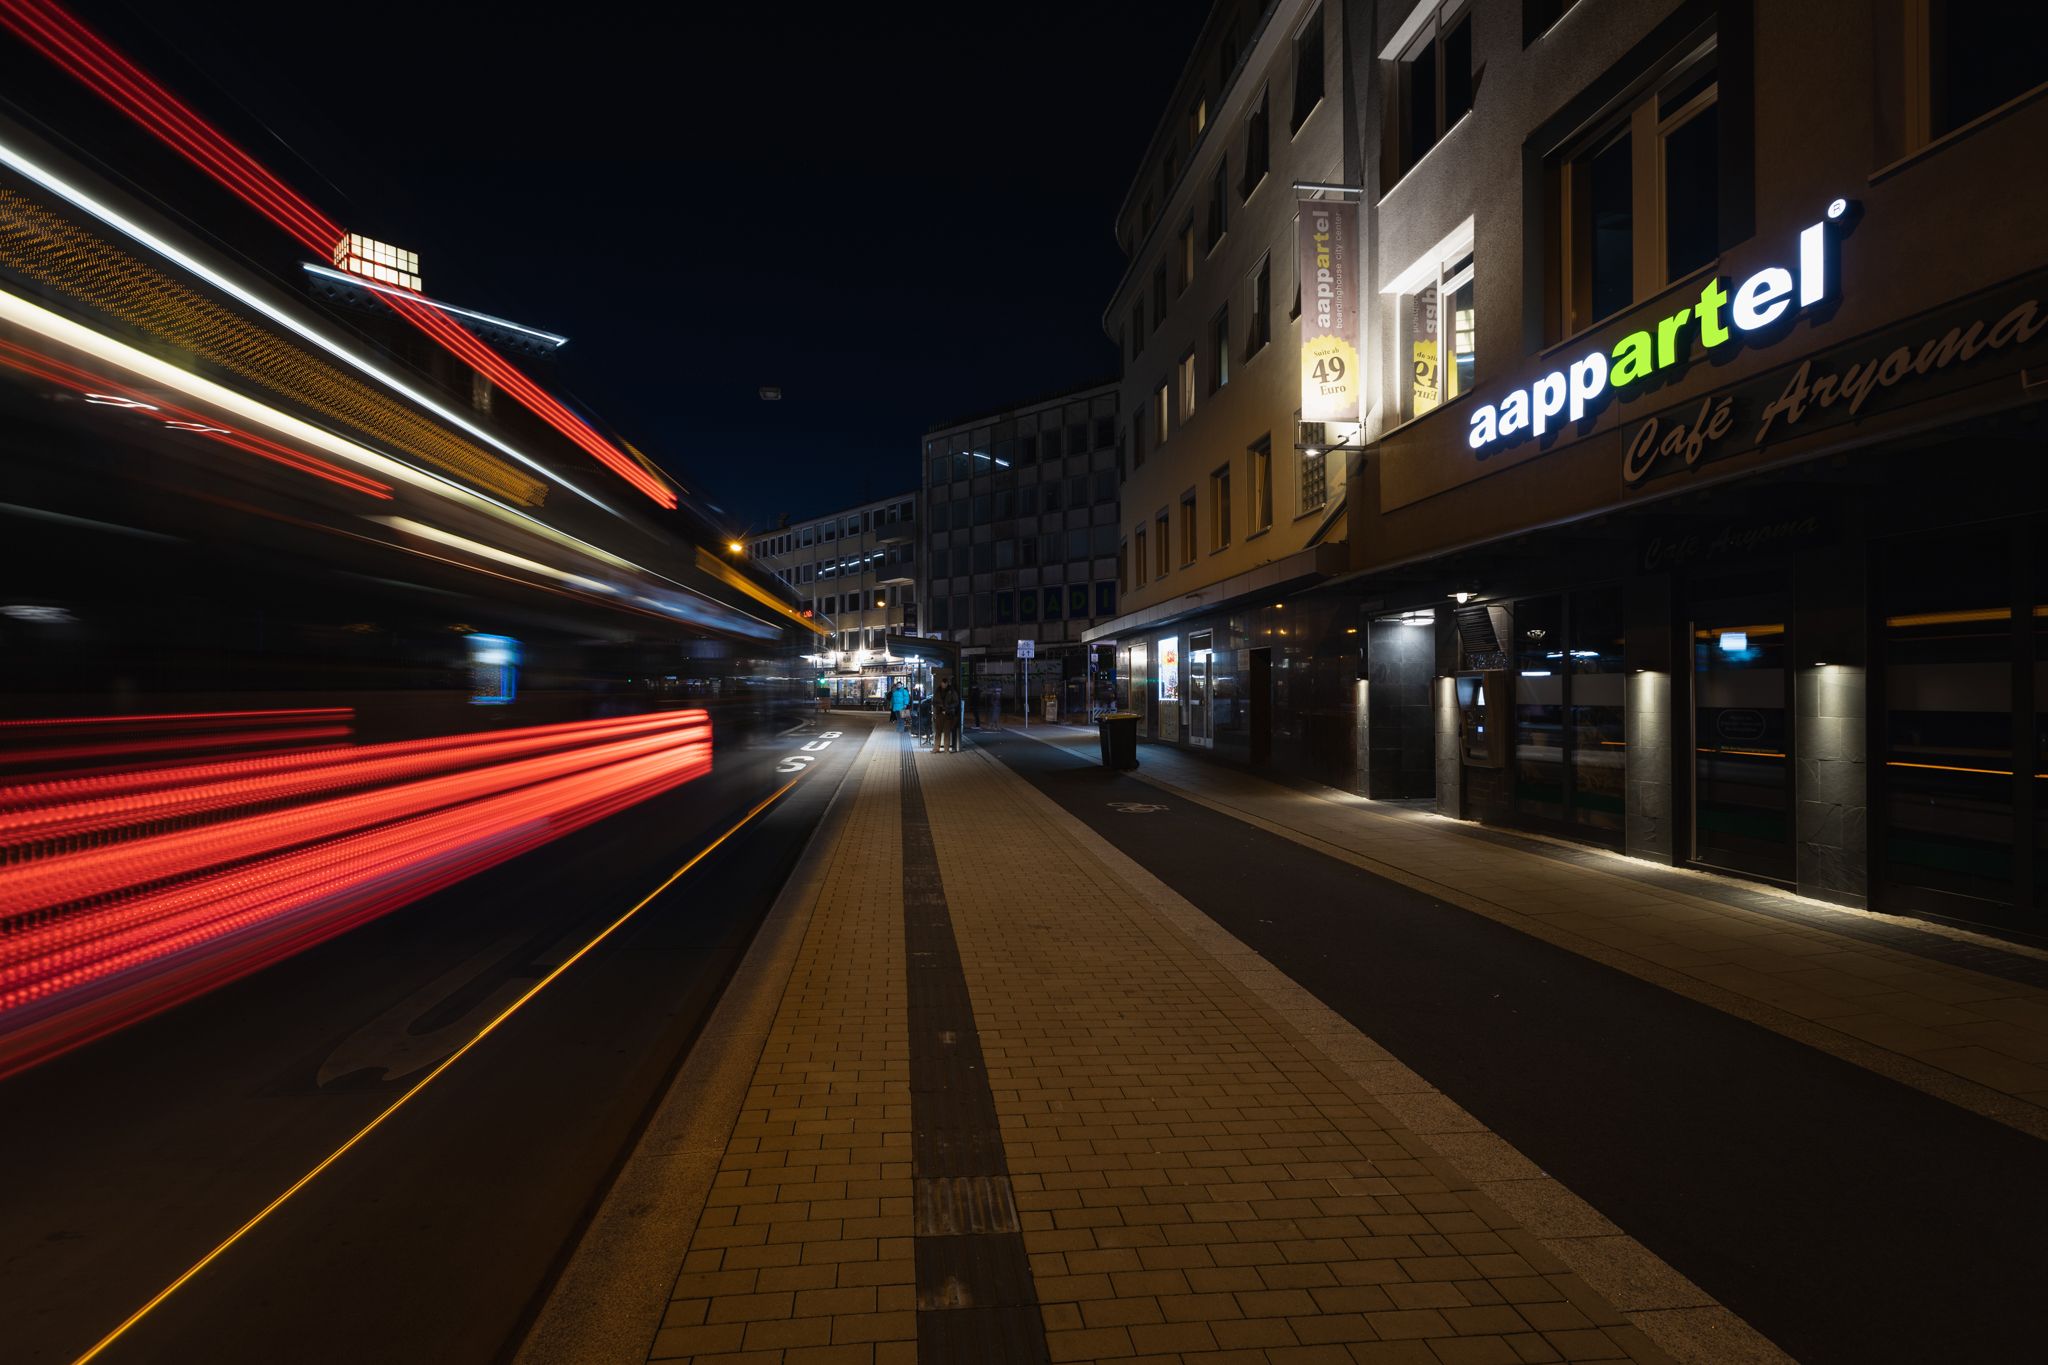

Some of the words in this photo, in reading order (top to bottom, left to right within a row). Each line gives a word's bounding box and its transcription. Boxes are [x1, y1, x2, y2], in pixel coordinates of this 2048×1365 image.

[1335, 213, 1343, 240] center
[1335, 244, 1344, 259] city
[1312, 210, 1334, 329] aappartel
[1335, 263, 1344, 329] boardinghouse
[1313, 348, 1331, 357] Suite
[1312, 356, 1346, 384] 49
[1320, 385, 1347, 396] Euro
[1623, 395, 1734, 482] Café
[1753, 300, 2048, 444] Aryoma
[776, 731, 843, 772] BUS
